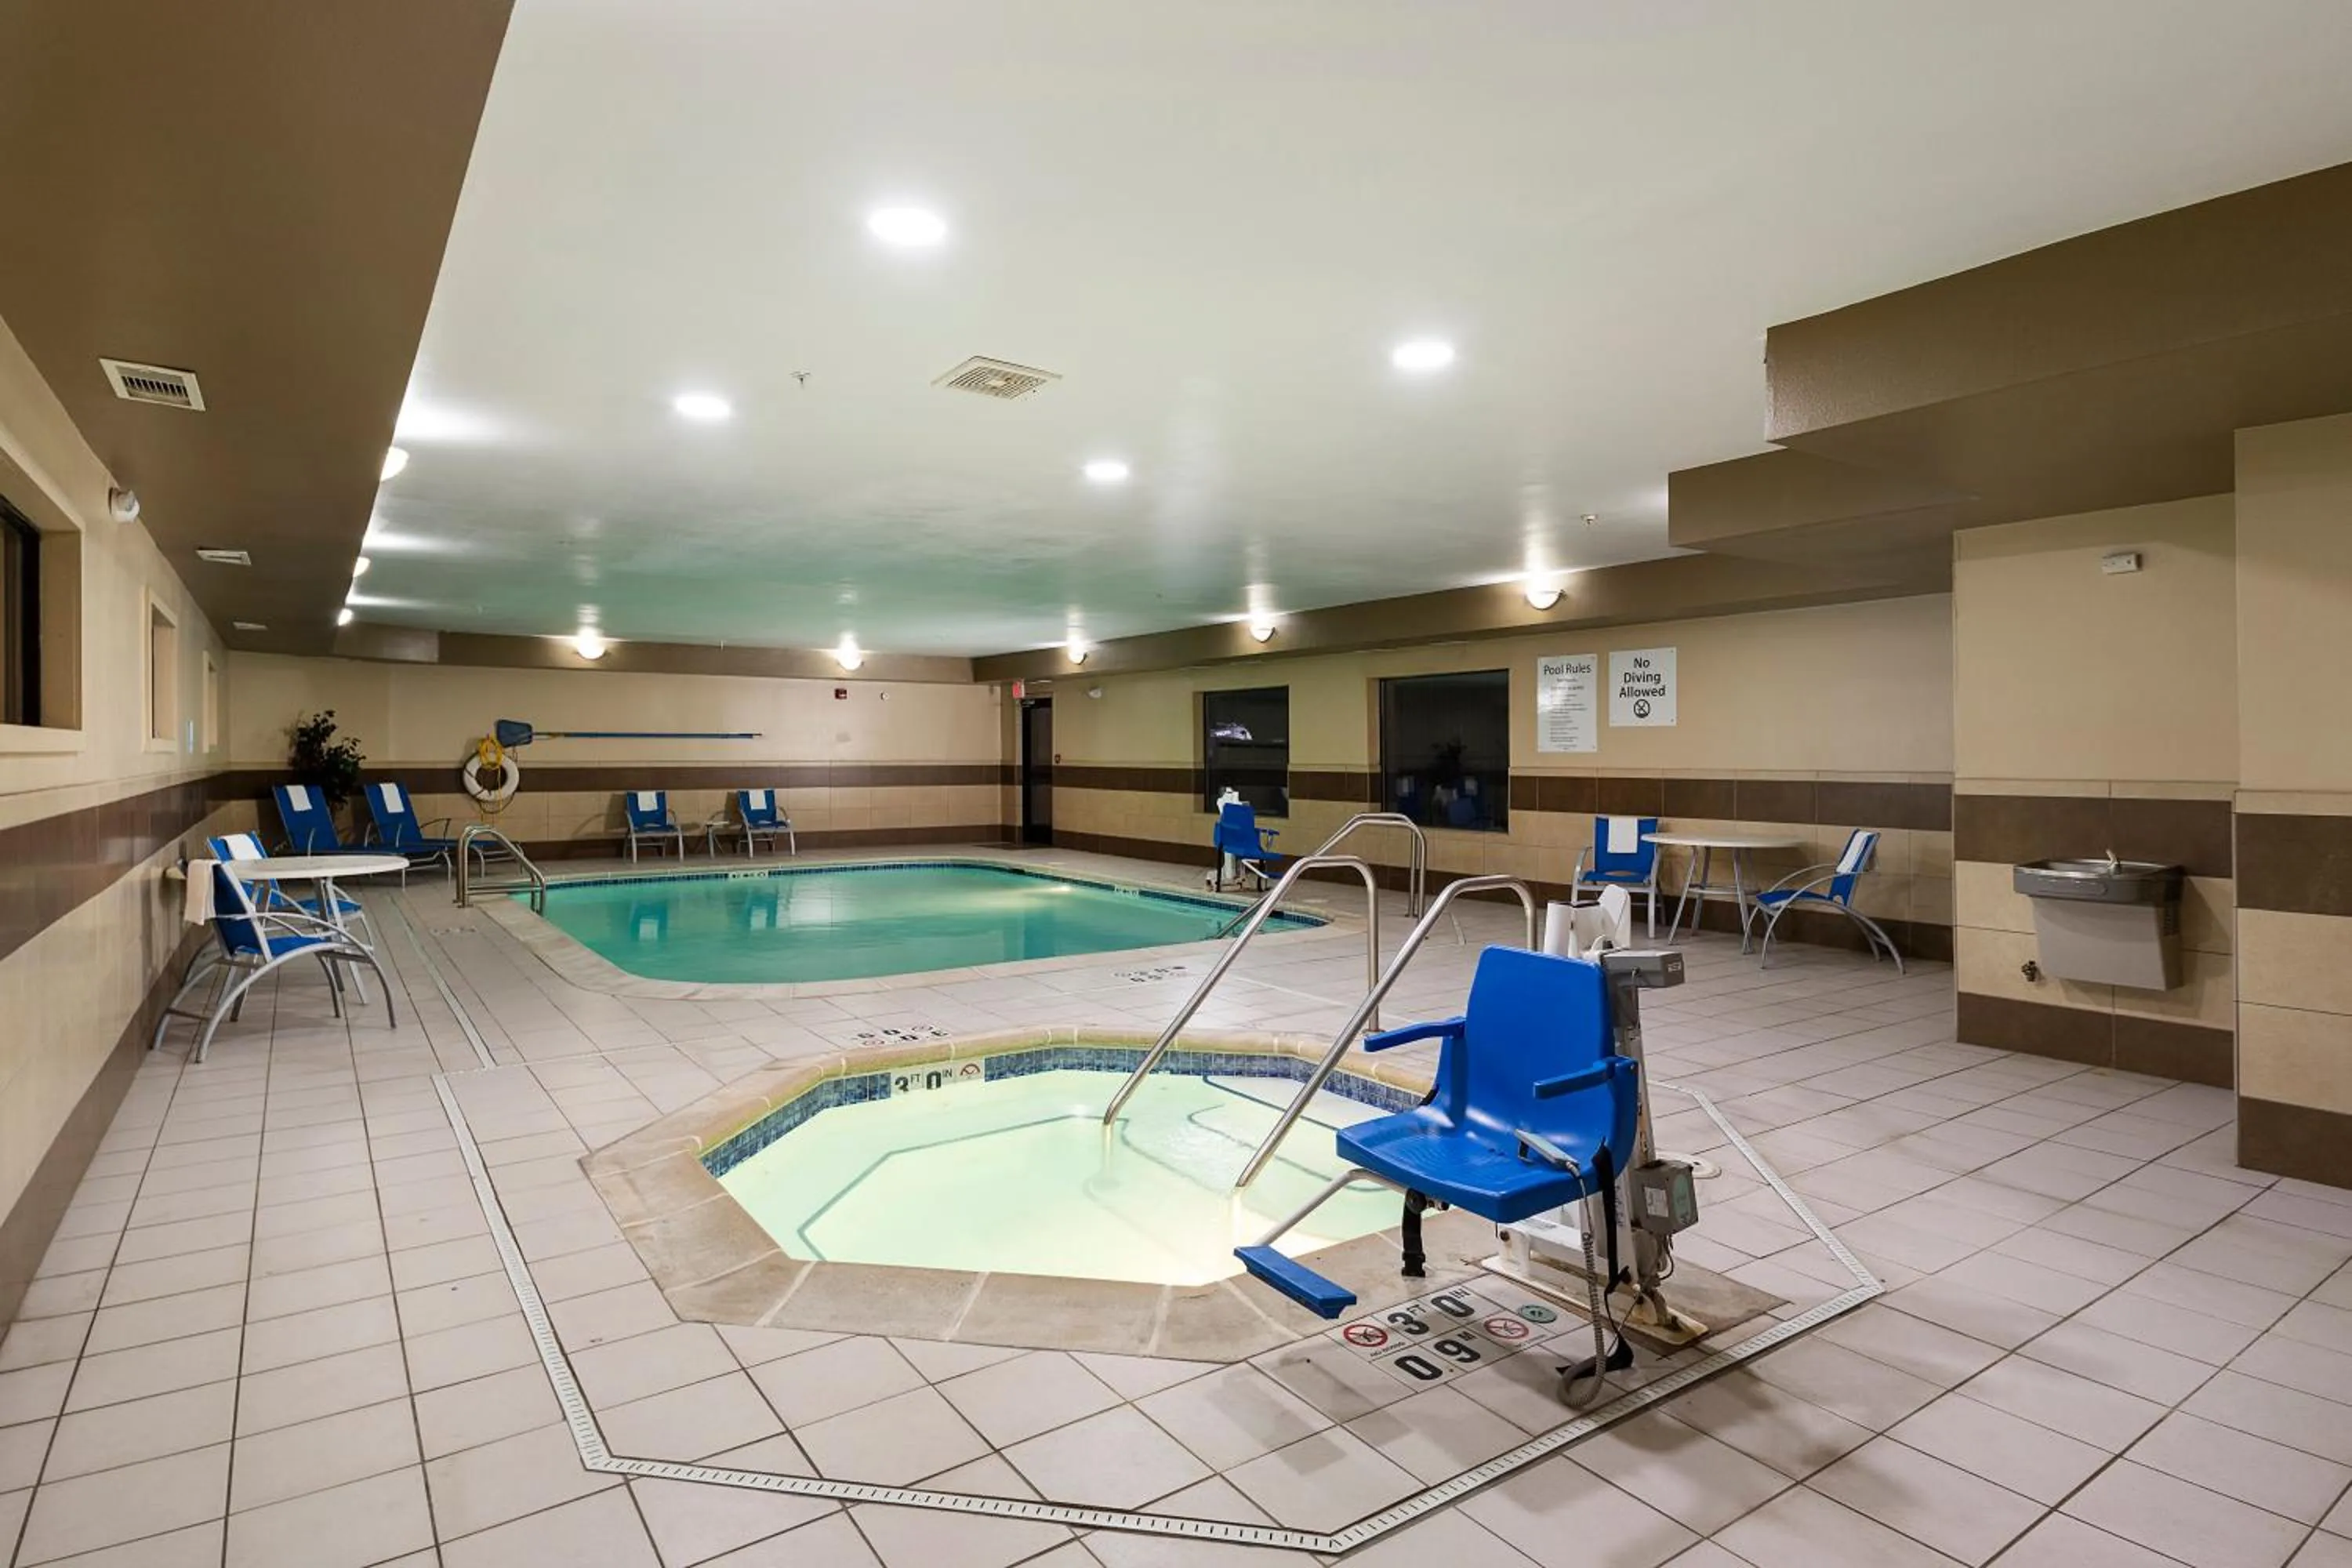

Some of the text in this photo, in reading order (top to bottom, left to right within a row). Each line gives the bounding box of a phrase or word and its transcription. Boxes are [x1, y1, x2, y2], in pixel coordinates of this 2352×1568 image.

[1544, 662, 1592, 675] Pool Rules
[1634, 657, 1650, 668] No
[1624, 671, 1661, 684] Diving
[1619, 685, 1666, 698] Allowed
[1387, 1312, 1429, 1335] 3
